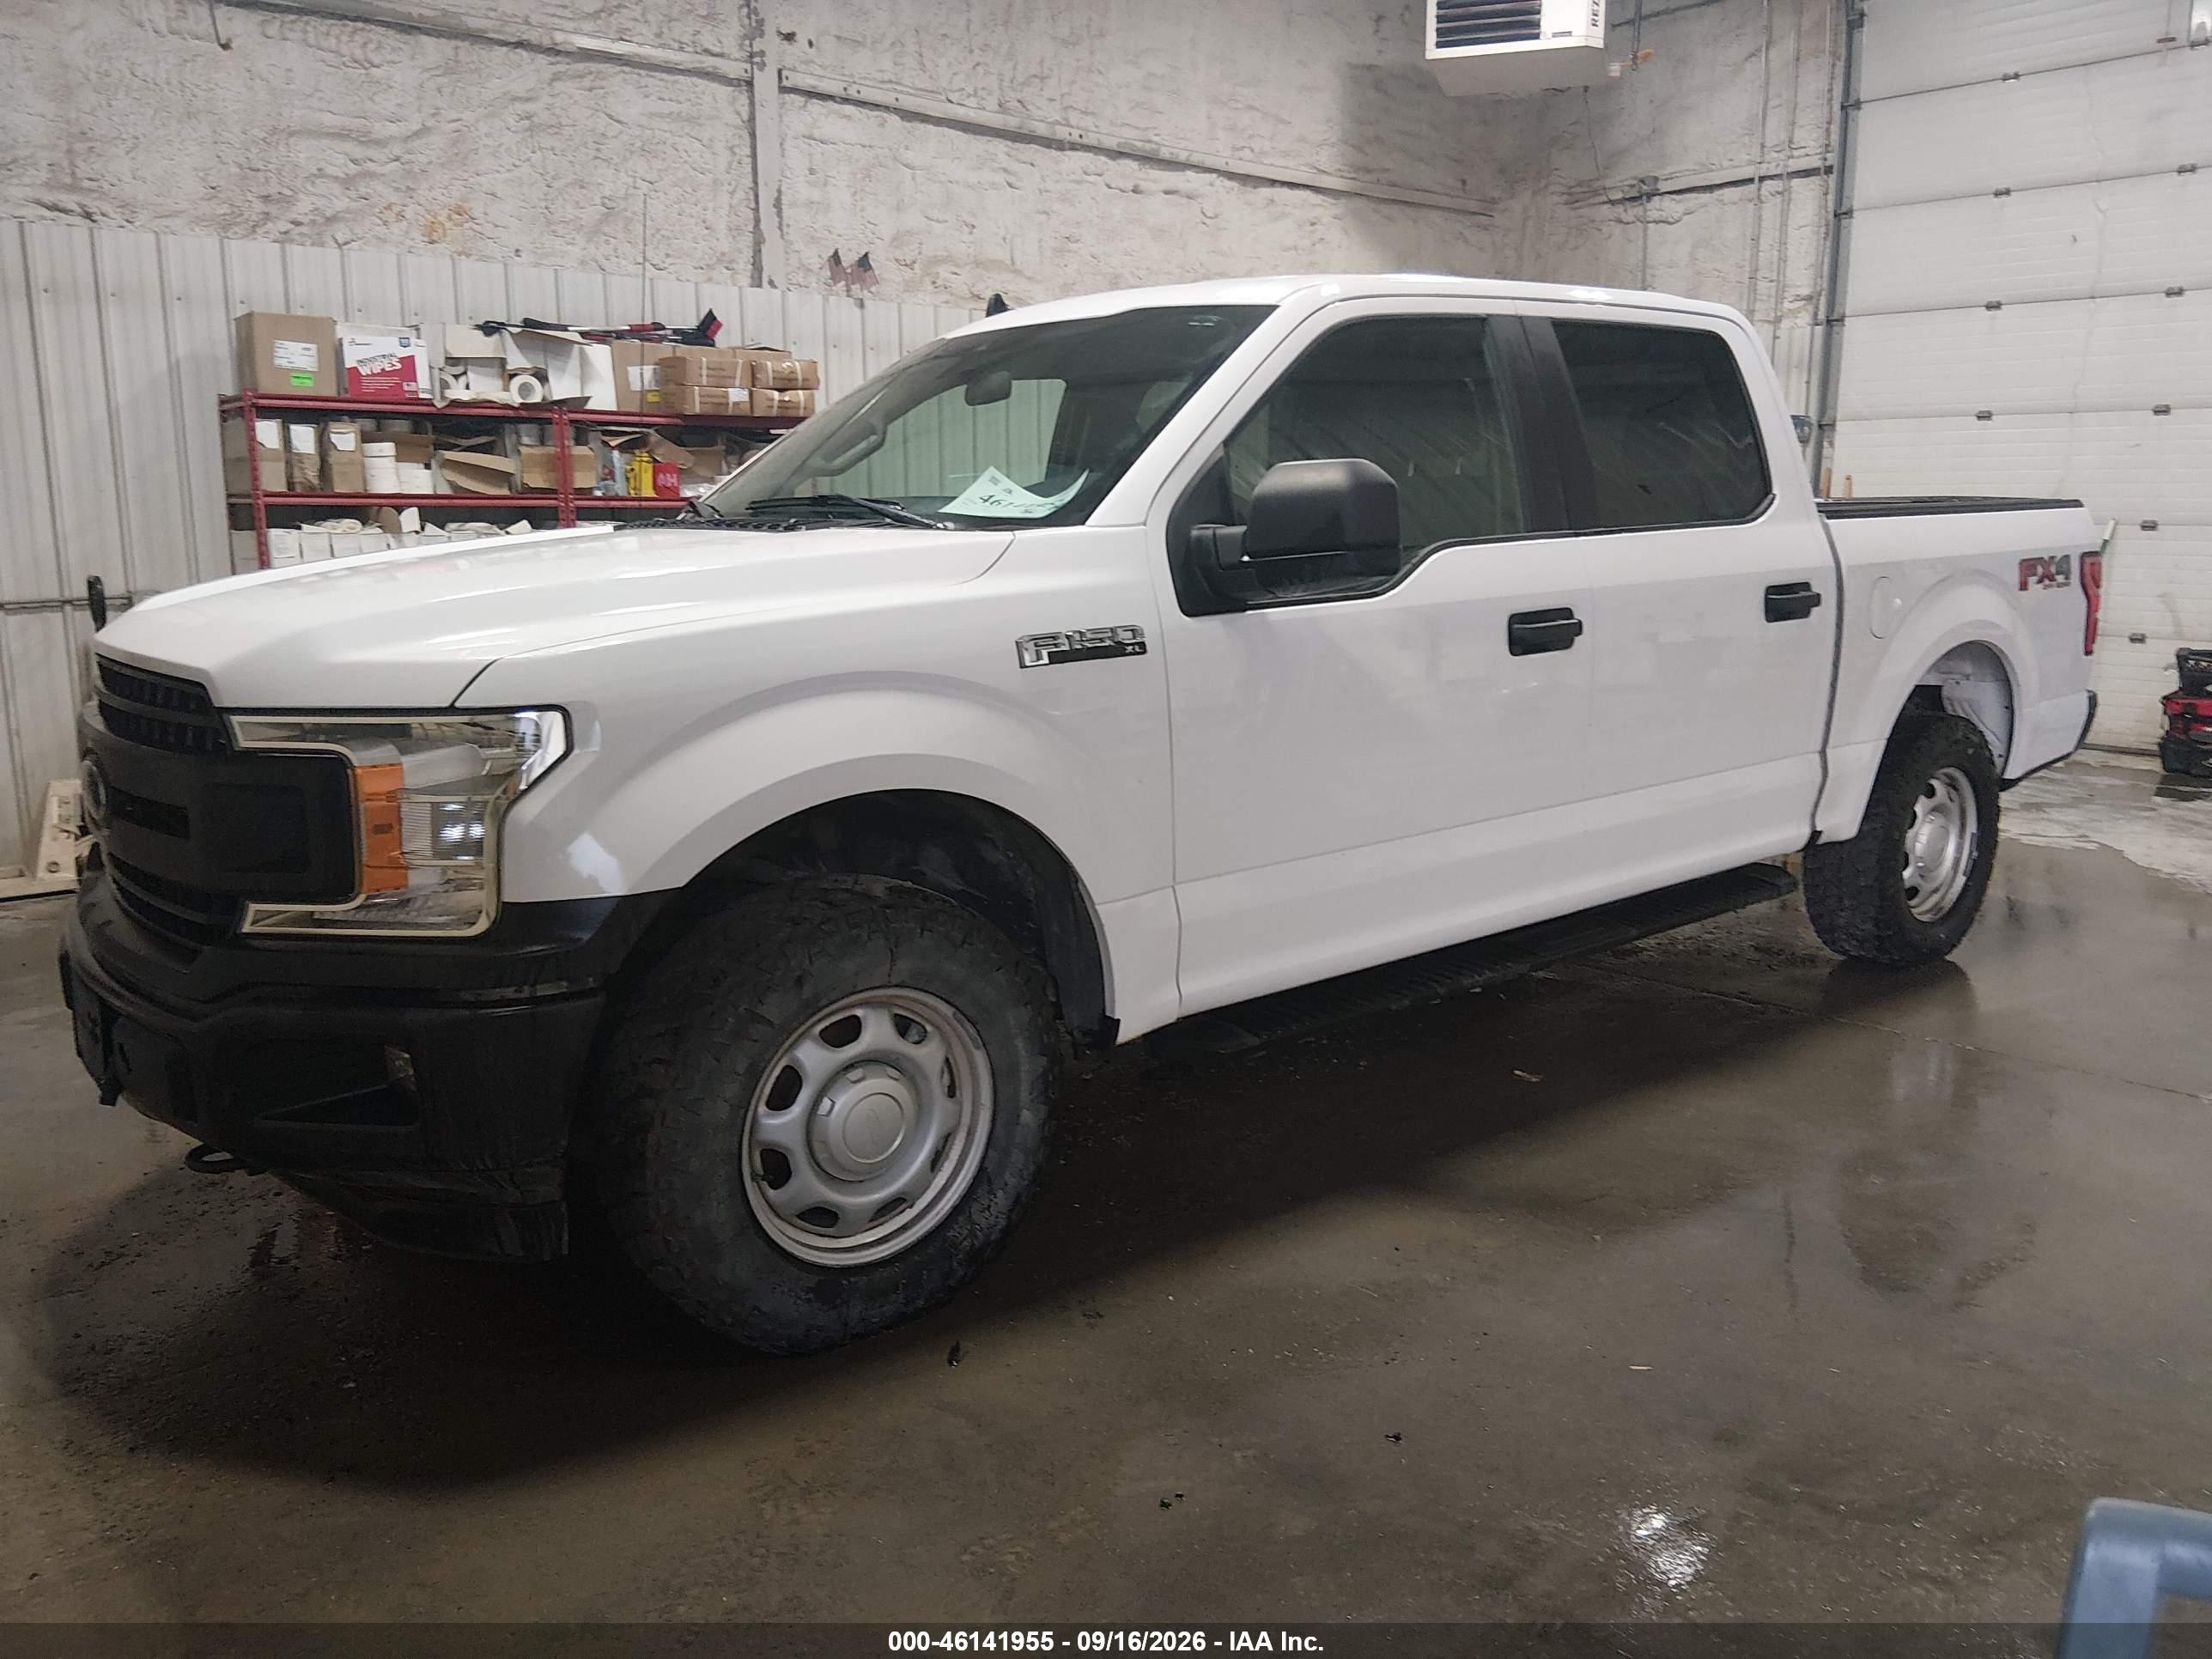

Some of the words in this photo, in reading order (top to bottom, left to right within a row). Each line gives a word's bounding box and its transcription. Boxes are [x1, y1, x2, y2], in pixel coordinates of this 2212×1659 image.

[357, 358, 403, 376] WIPES
[2019, 555, 2071, 591] FX4
[1124, 645, 1145, 653] XL
